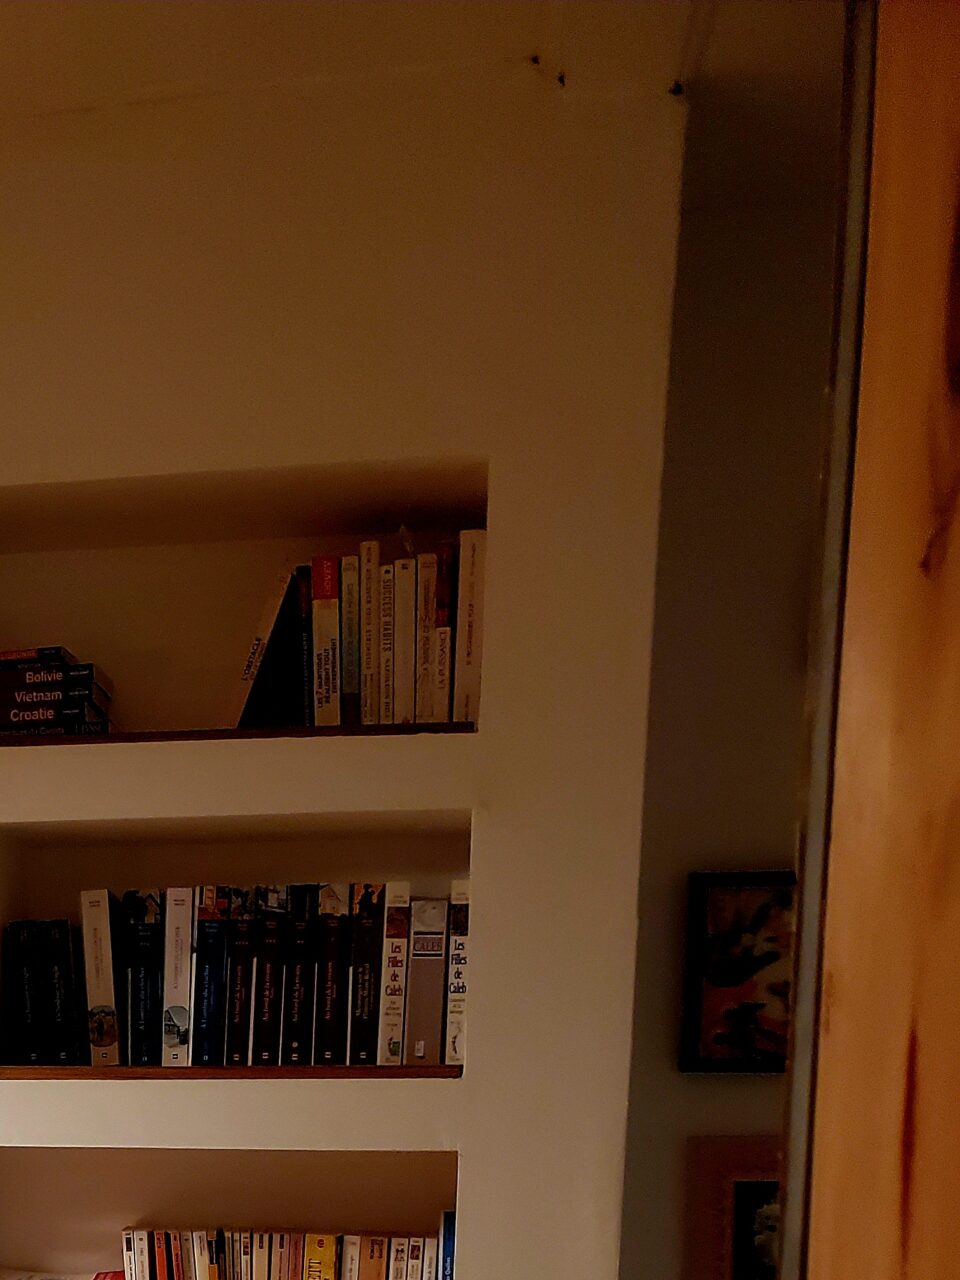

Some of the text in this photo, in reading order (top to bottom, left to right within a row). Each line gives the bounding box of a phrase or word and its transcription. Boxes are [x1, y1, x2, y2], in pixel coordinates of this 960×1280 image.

[382, 578, 392, 618] SUCCESS
[382, 621, 392, 652] HABITS
[25, 670, 65, 684] Bolivie
[14, 690, 63, 704] Vietnam
[10, 708, 56, 722] Croatie
[391, 942, 402, 954] Les
[413, 940, 443, 952] CALEB
[454, 939, 465, 951] Les
[387, 956, 403, 969] Filles
[450, 953, 467, 966] Filles
[390, 969, 400, 982] de
[453, 967, 463, 979] de
[385, 983, 403, 997] Caleb
[449, 982, 467, 994] Caleb
